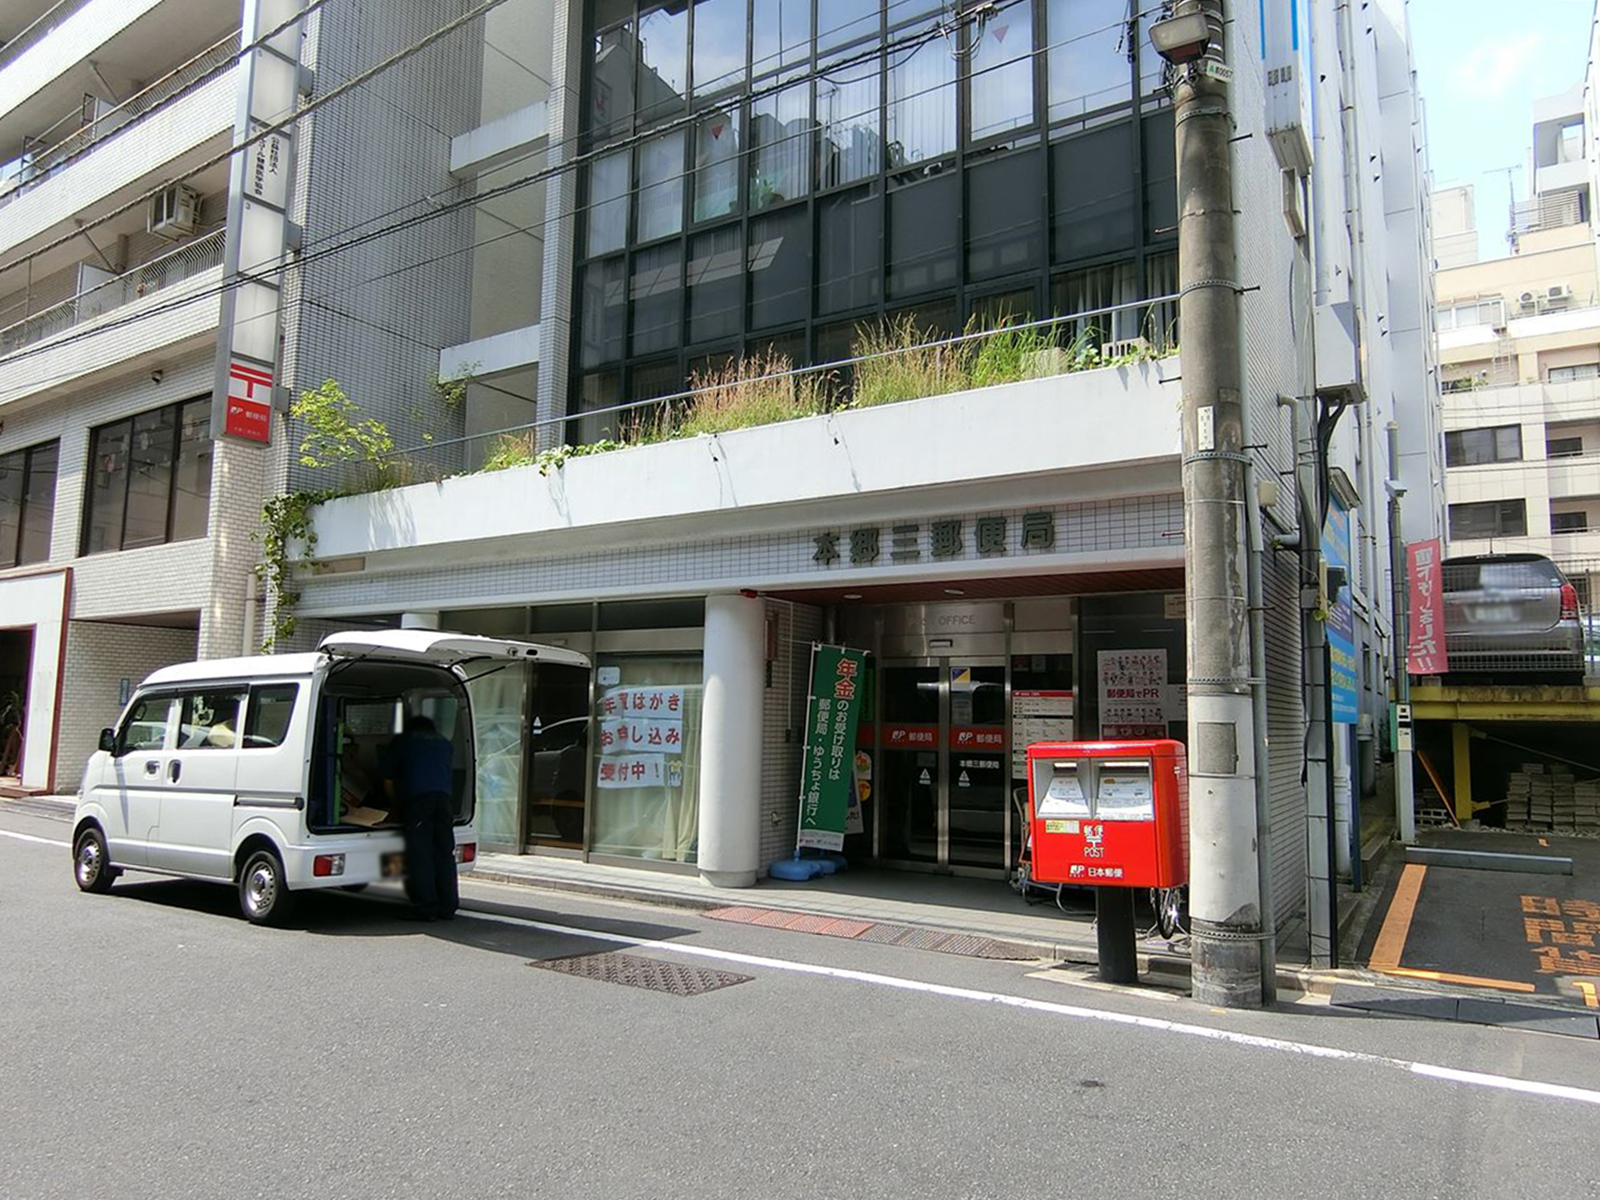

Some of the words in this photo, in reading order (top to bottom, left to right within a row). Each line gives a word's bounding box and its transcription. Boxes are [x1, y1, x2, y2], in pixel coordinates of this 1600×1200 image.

[254, 129, 266, 196] コール健康医学協会
[812, 511, 1055, 565] 本郷三郵便局
[938, 614, 976, 626] OFFICE
[1107, 688, 1160, 699] 郵便局でPR
[829, 657, 859, 781] 年金のお受け取りは
[601, 725, 680, 747] お申し込み
[908, 732, 933, 742] 郵便局
[976, 733, 1003, 744] 郵便局
[805, 698, 832, 826] 郵便局・ゆうちょ銀行へ
[960, 760, 1000, 769] 本郷三郵便局
[1084, 825, 1104, 837] 郵便
[1084, 847, 1104, 858] POST
[1088, 867, 1124, 878] 日本郵便
